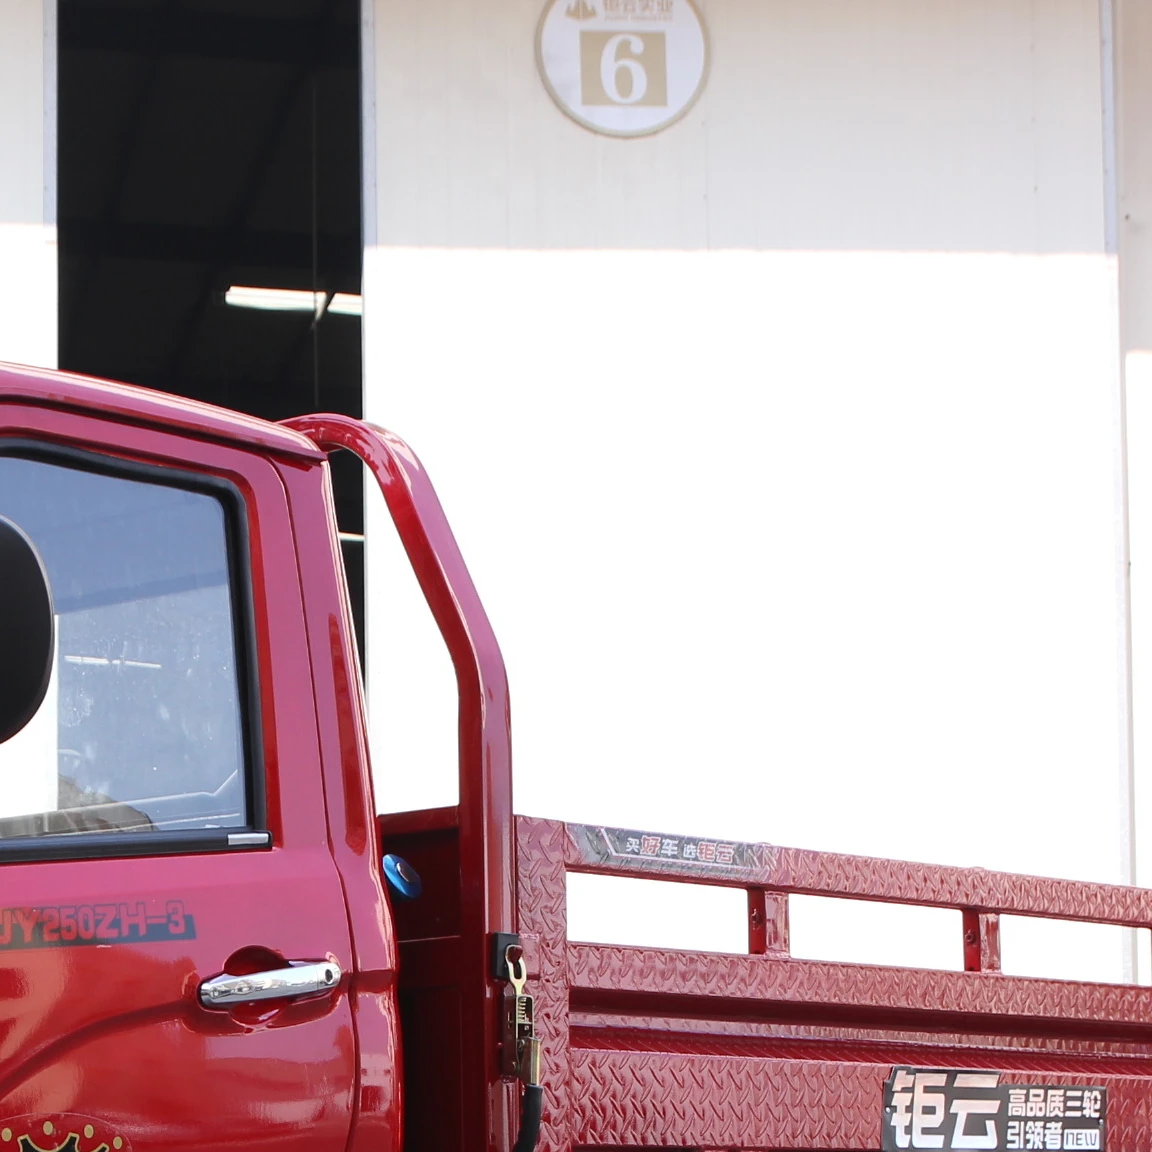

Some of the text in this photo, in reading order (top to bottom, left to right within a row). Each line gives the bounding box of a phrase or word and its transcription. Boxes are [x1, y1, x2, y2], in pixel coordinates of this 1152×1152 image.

[600, 33, 648, 104] 6
[890, 1070, 1001, 1149] 钜云
[1007, 1088, 1102, 1118] 高品质三轮
[1006, 1120, 1063, 1149] 引领者
